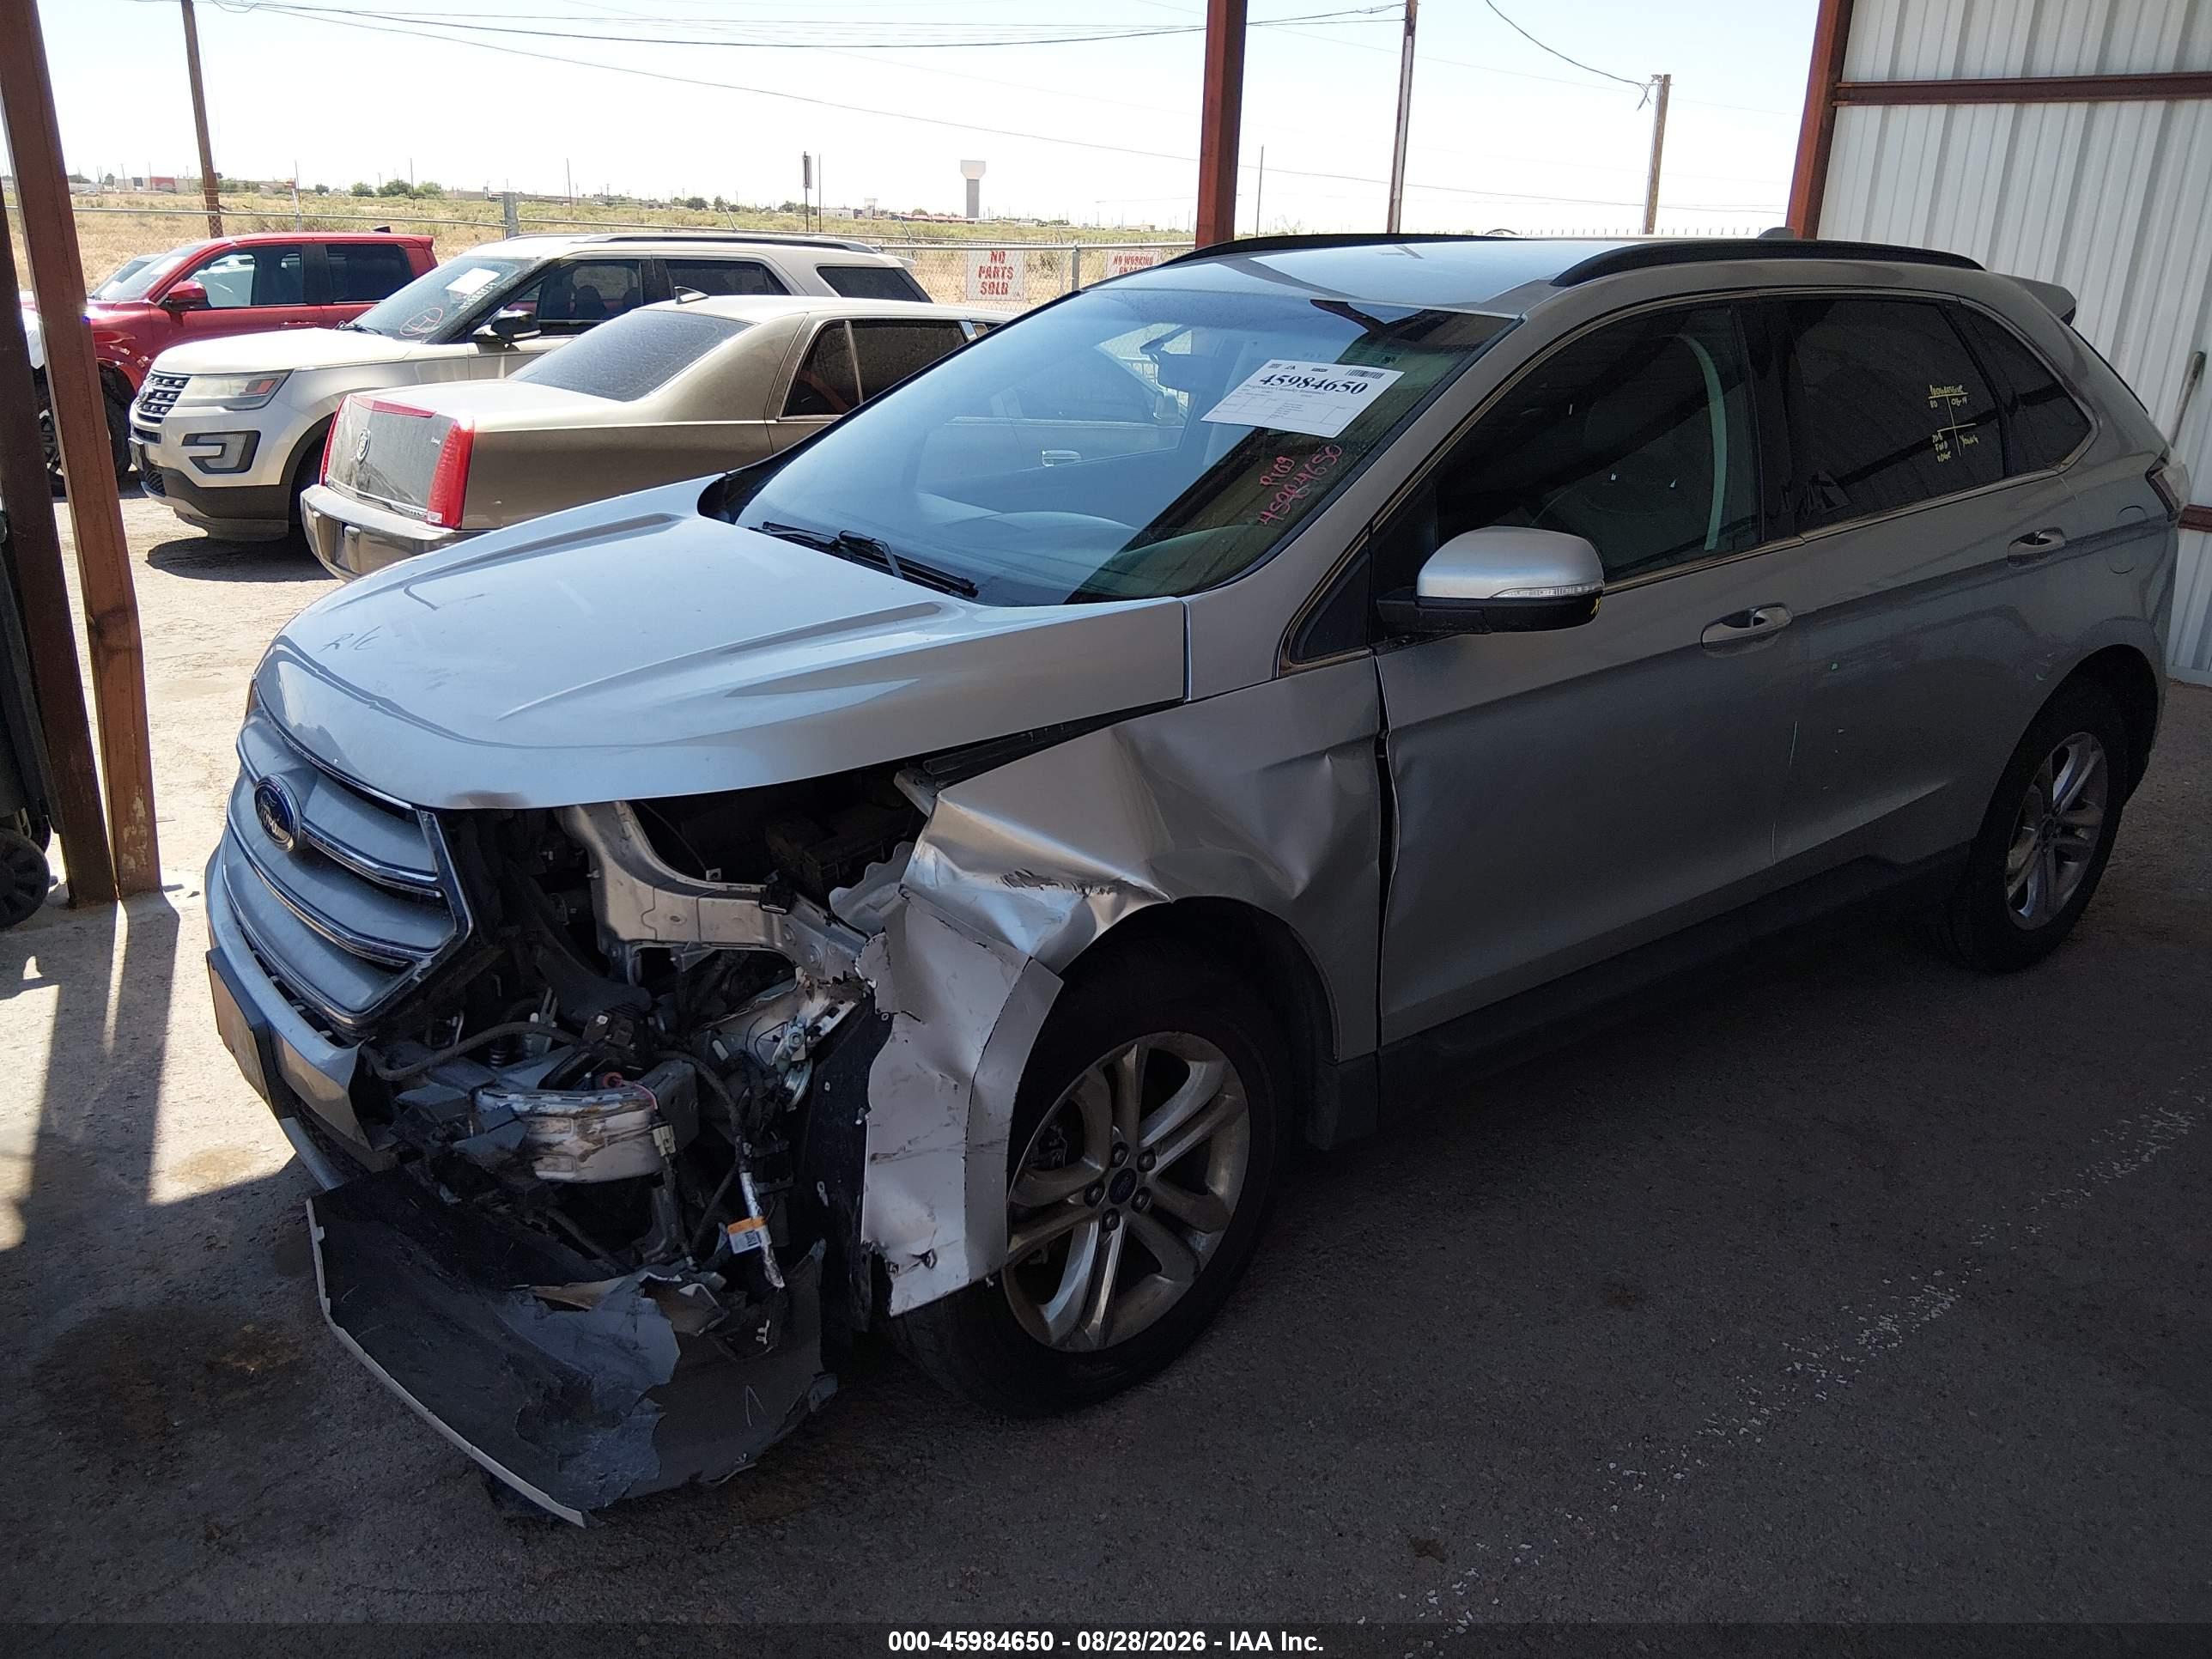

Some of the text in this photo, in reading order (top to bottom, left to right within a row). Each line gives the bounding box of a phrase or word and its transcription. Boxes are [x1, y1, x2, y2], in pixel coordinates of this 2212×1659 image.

[990, 251, 1006, 264] NO
[978, 265, 1014, 280] PARTS
[980, 281, 1009, 295] SOLD
[1259, 374, 1369, 395] 45984650
[1257, 445, 1343, 525] 45984650
